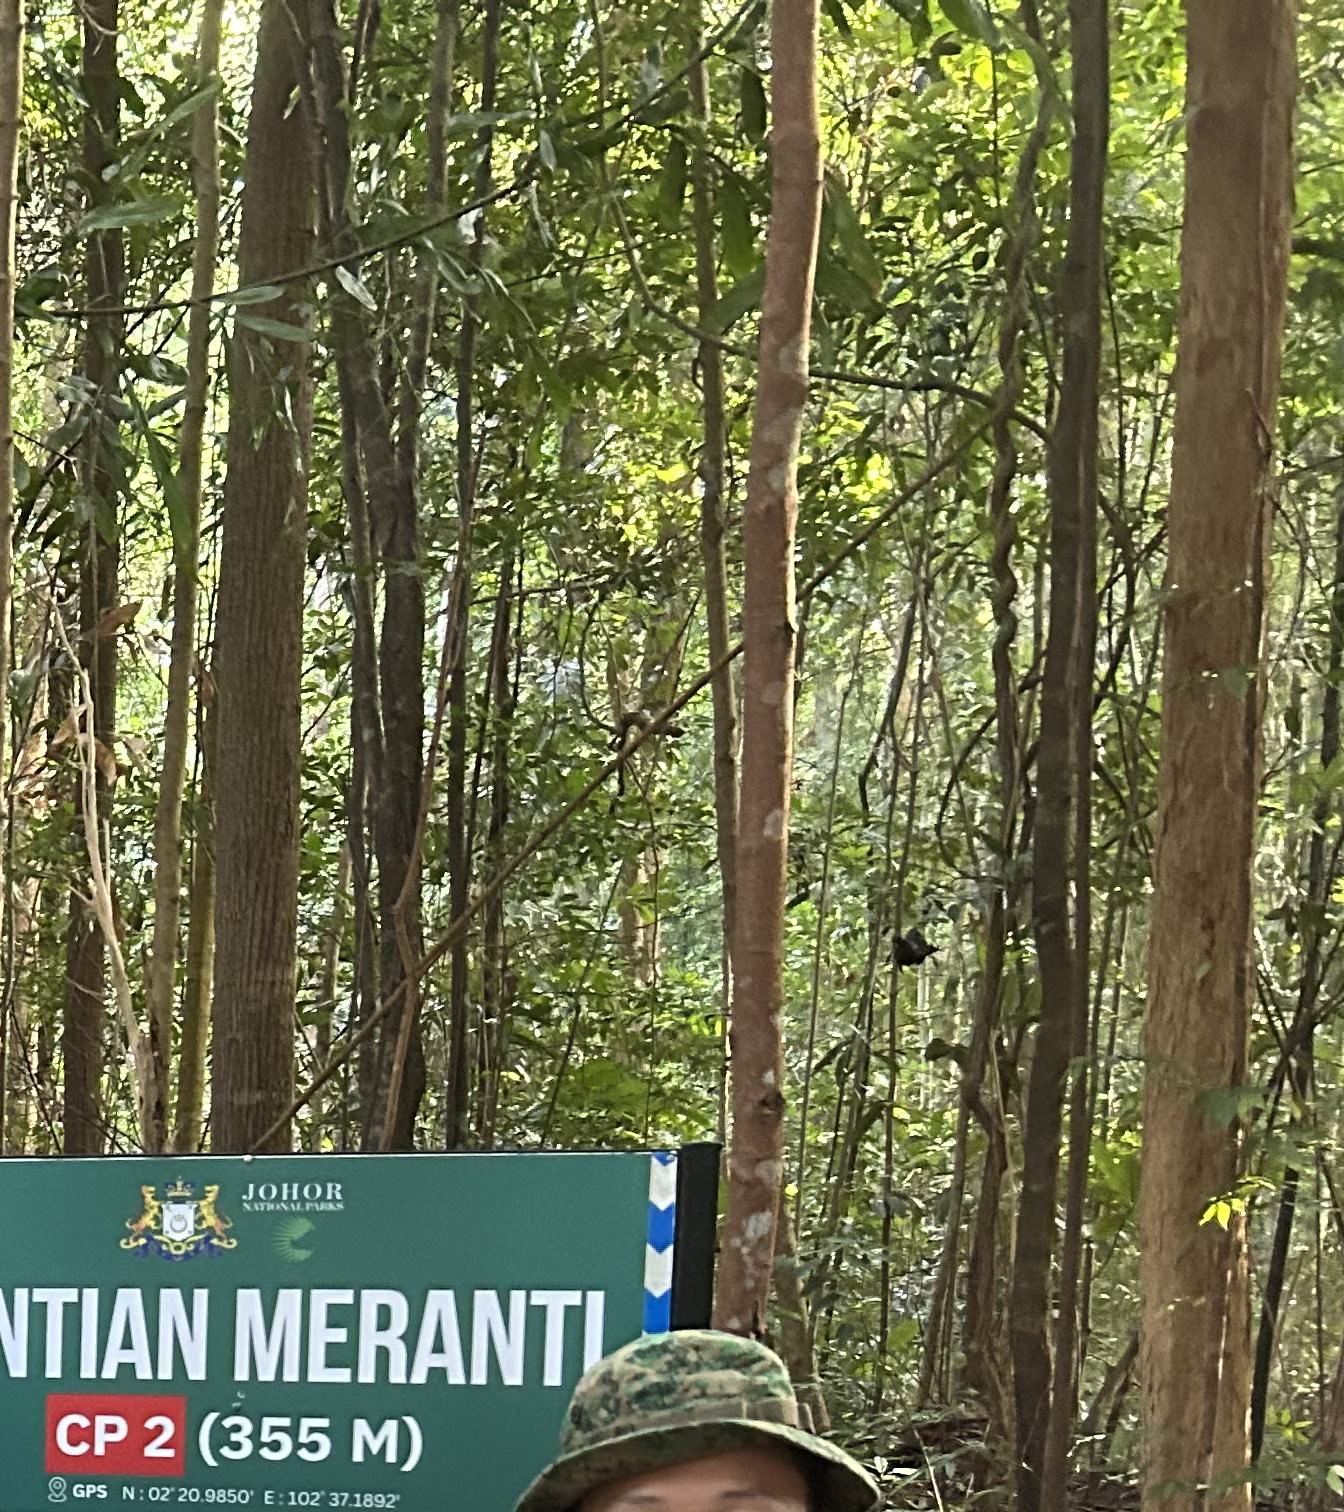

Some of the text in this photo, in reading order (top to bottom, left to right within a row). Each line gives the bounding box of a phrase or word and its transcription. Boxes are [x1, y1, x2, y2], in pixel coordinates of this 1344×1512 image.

[242, 1183, 343, 1201] JOHOR
[243, 1202, 345, 1212] NATIONAL PARKS
[233, 1288, 605, 1387] MERANTI
[55, 1412, 423, 1472] CP 2 (355 M)
[72, 1485, 108, 1499] GPS
